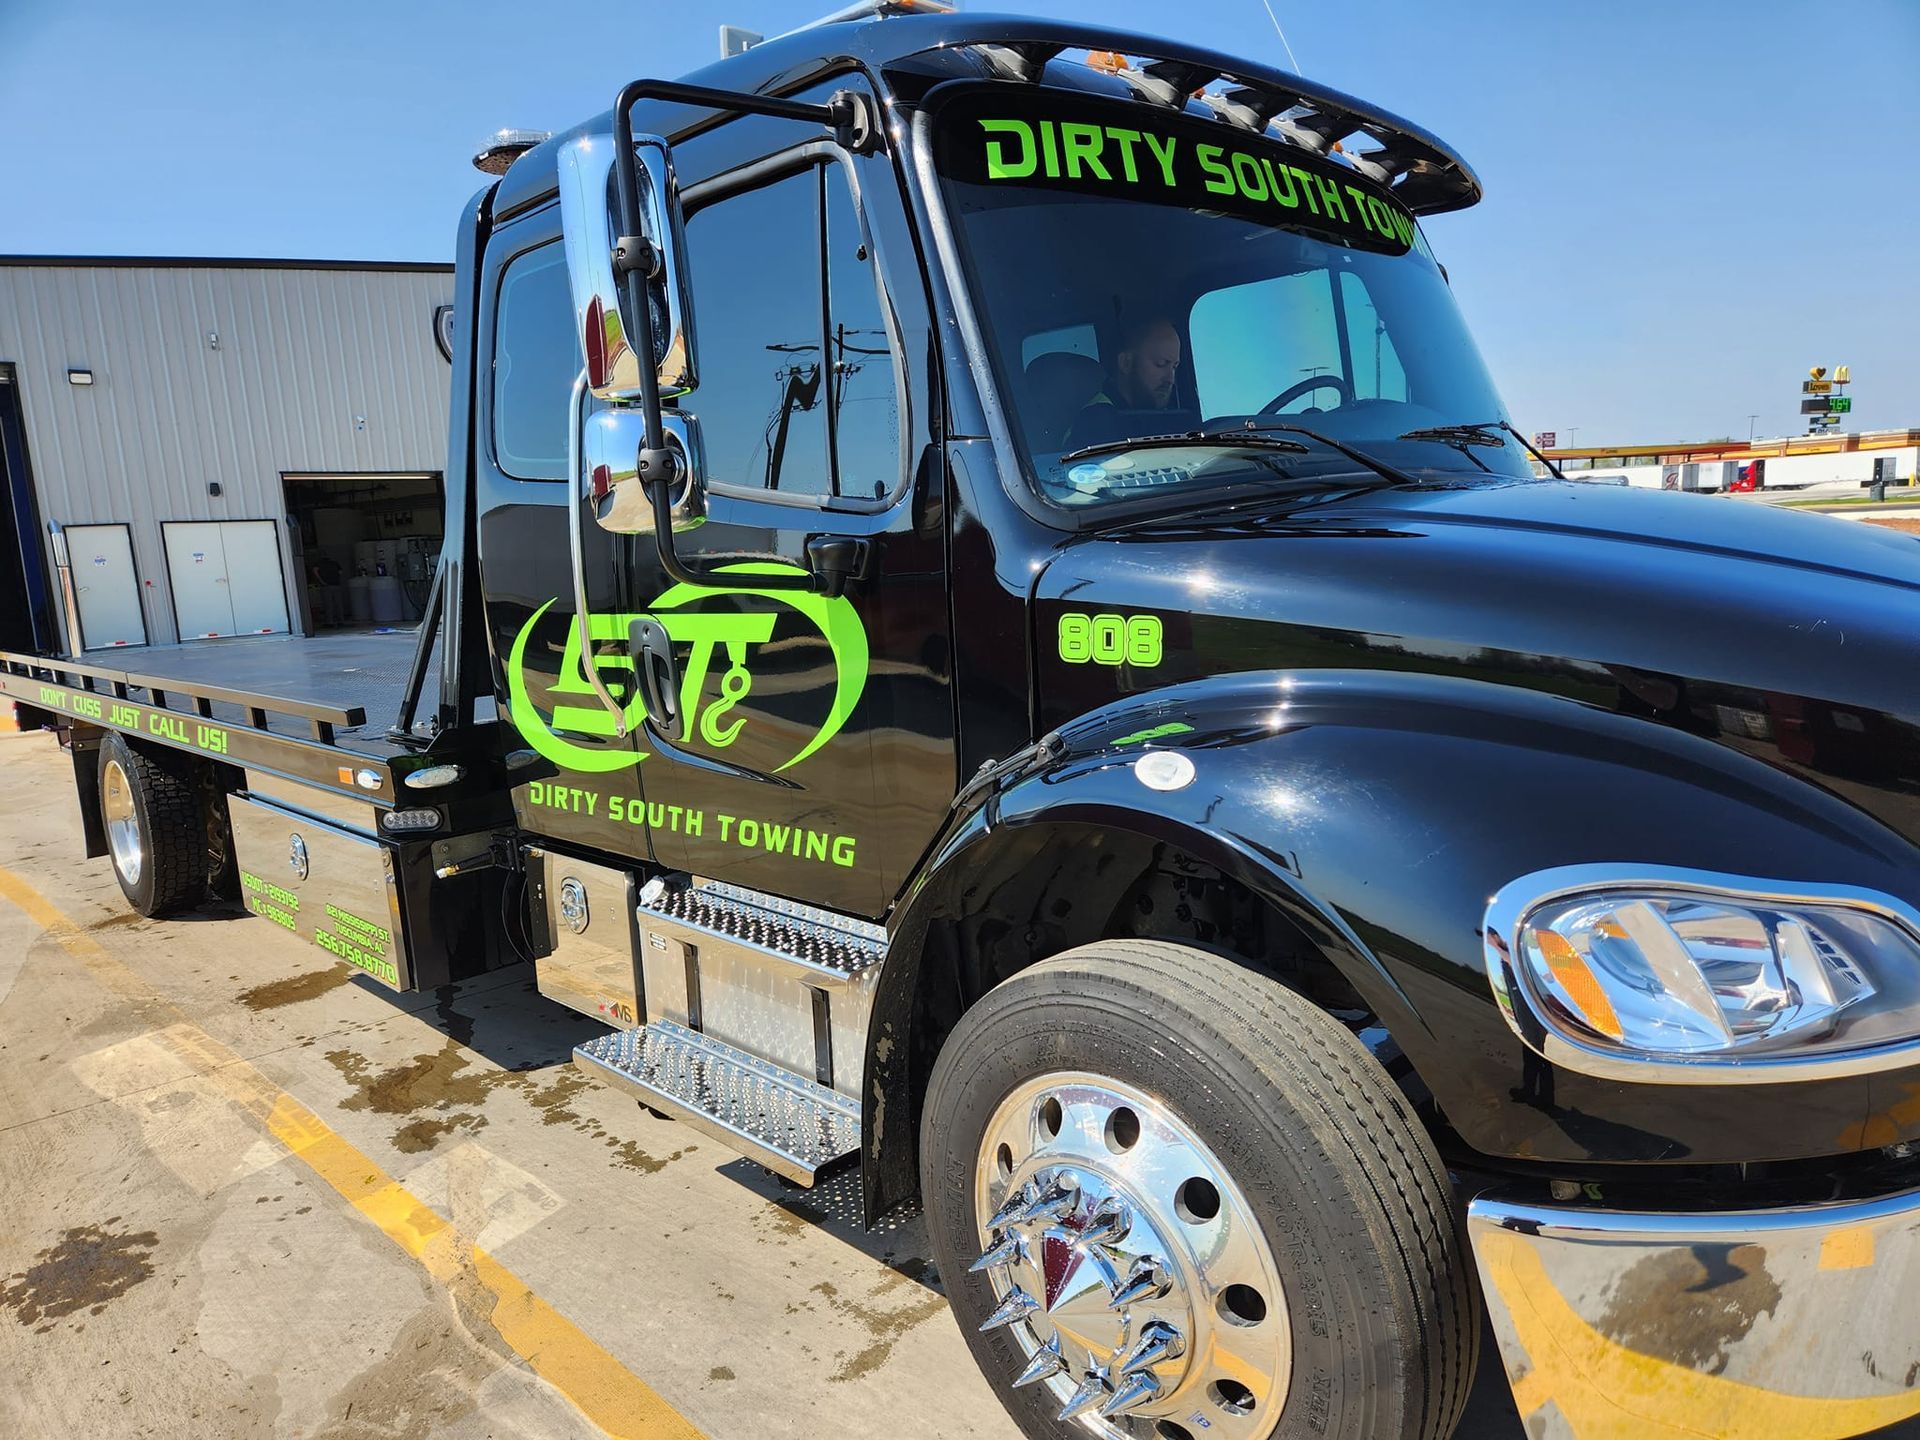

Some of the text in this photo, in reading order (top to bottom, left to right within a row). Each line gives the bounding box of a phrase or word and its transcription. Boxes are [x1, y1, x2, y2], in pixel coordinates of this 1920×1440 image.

[978, 119, 1177, 187] DIRTY
[1196, 143, 1350, 223] SOUTH
[1058, 612, 1163, 667] 808
[40, 686, 228, 754] DON'T CUSS JUST CALL US!
[528, 781, 857, 868] DIRTY SOUTH TOWING
